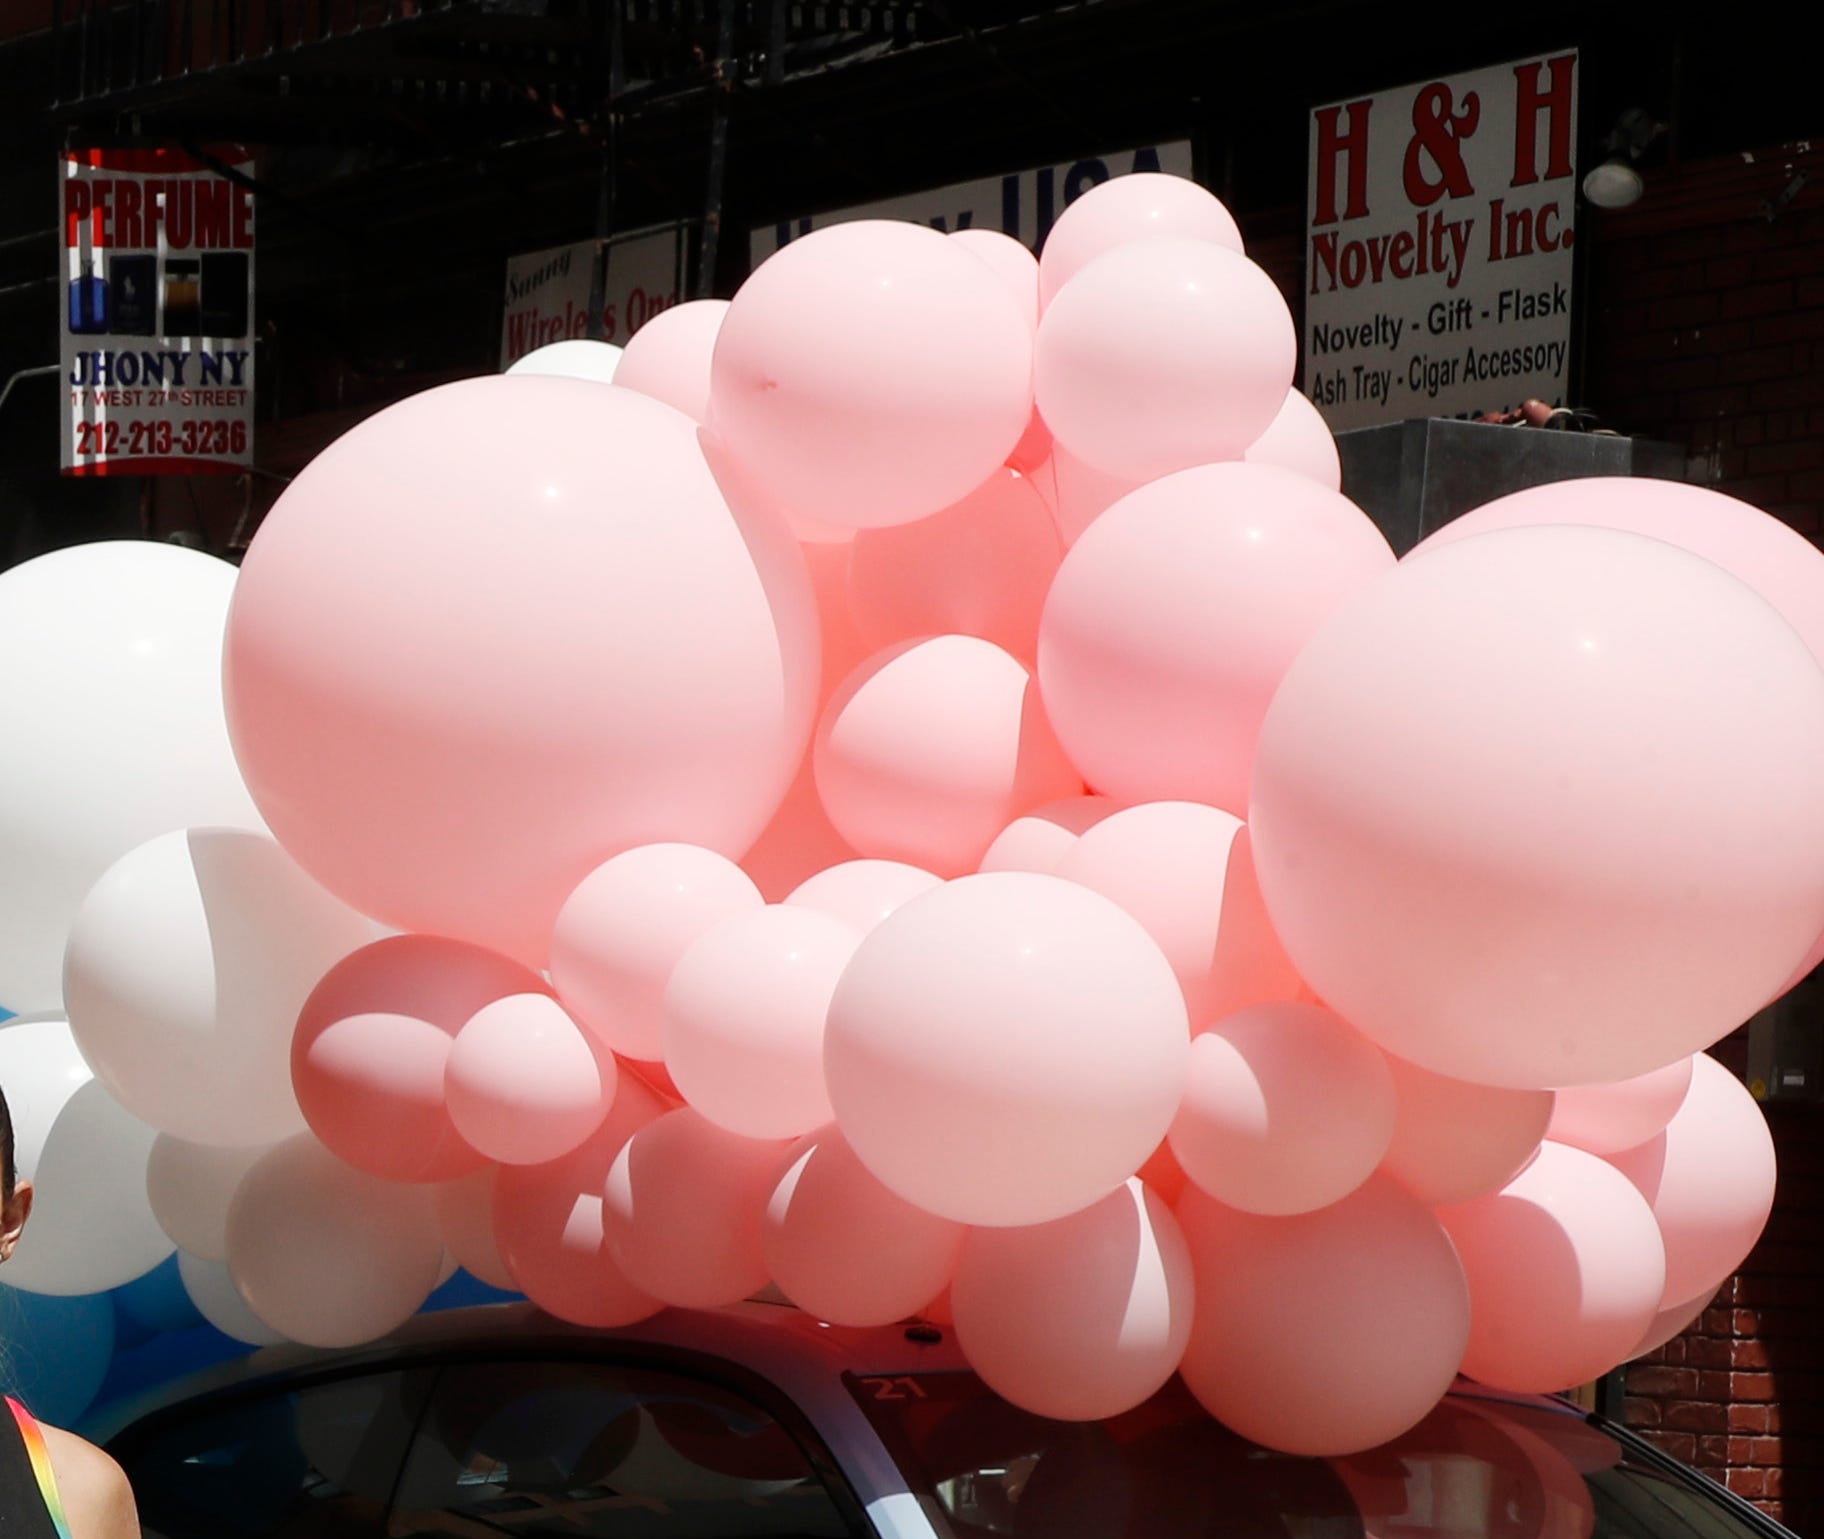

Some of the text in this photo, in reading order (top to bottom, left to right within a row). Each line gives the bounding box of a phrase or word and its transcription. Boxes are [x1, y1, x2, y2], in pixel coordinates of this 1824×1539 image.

[1312, 53, 1577, 227] H & H
[64, 179, 254, 249] PERFUME
[1310, 198, 1574, 295] Novelty Inc.
[508, 299, 617, 361] Wireles
[1312, 313, 1403, 355] Novelty
[1427, 299, 1473, 336] Gift
[1497, 282, 1567, 323] Flask
[70, 350, 249, 387] JHONY NY
[72, 391, 89, 407] 17
[94, 390, 143, 407] WEST
[181, 390, 248, 407] STREET
[1312, 372, 1347, 406] Ash
[1354, 366, 1392, 409] Tray
[1409, 355, 1458, 399] Cigar
[1463, 340, 1566, 383] Accessory
[76, 418, 247, 455] 212-213-3236
